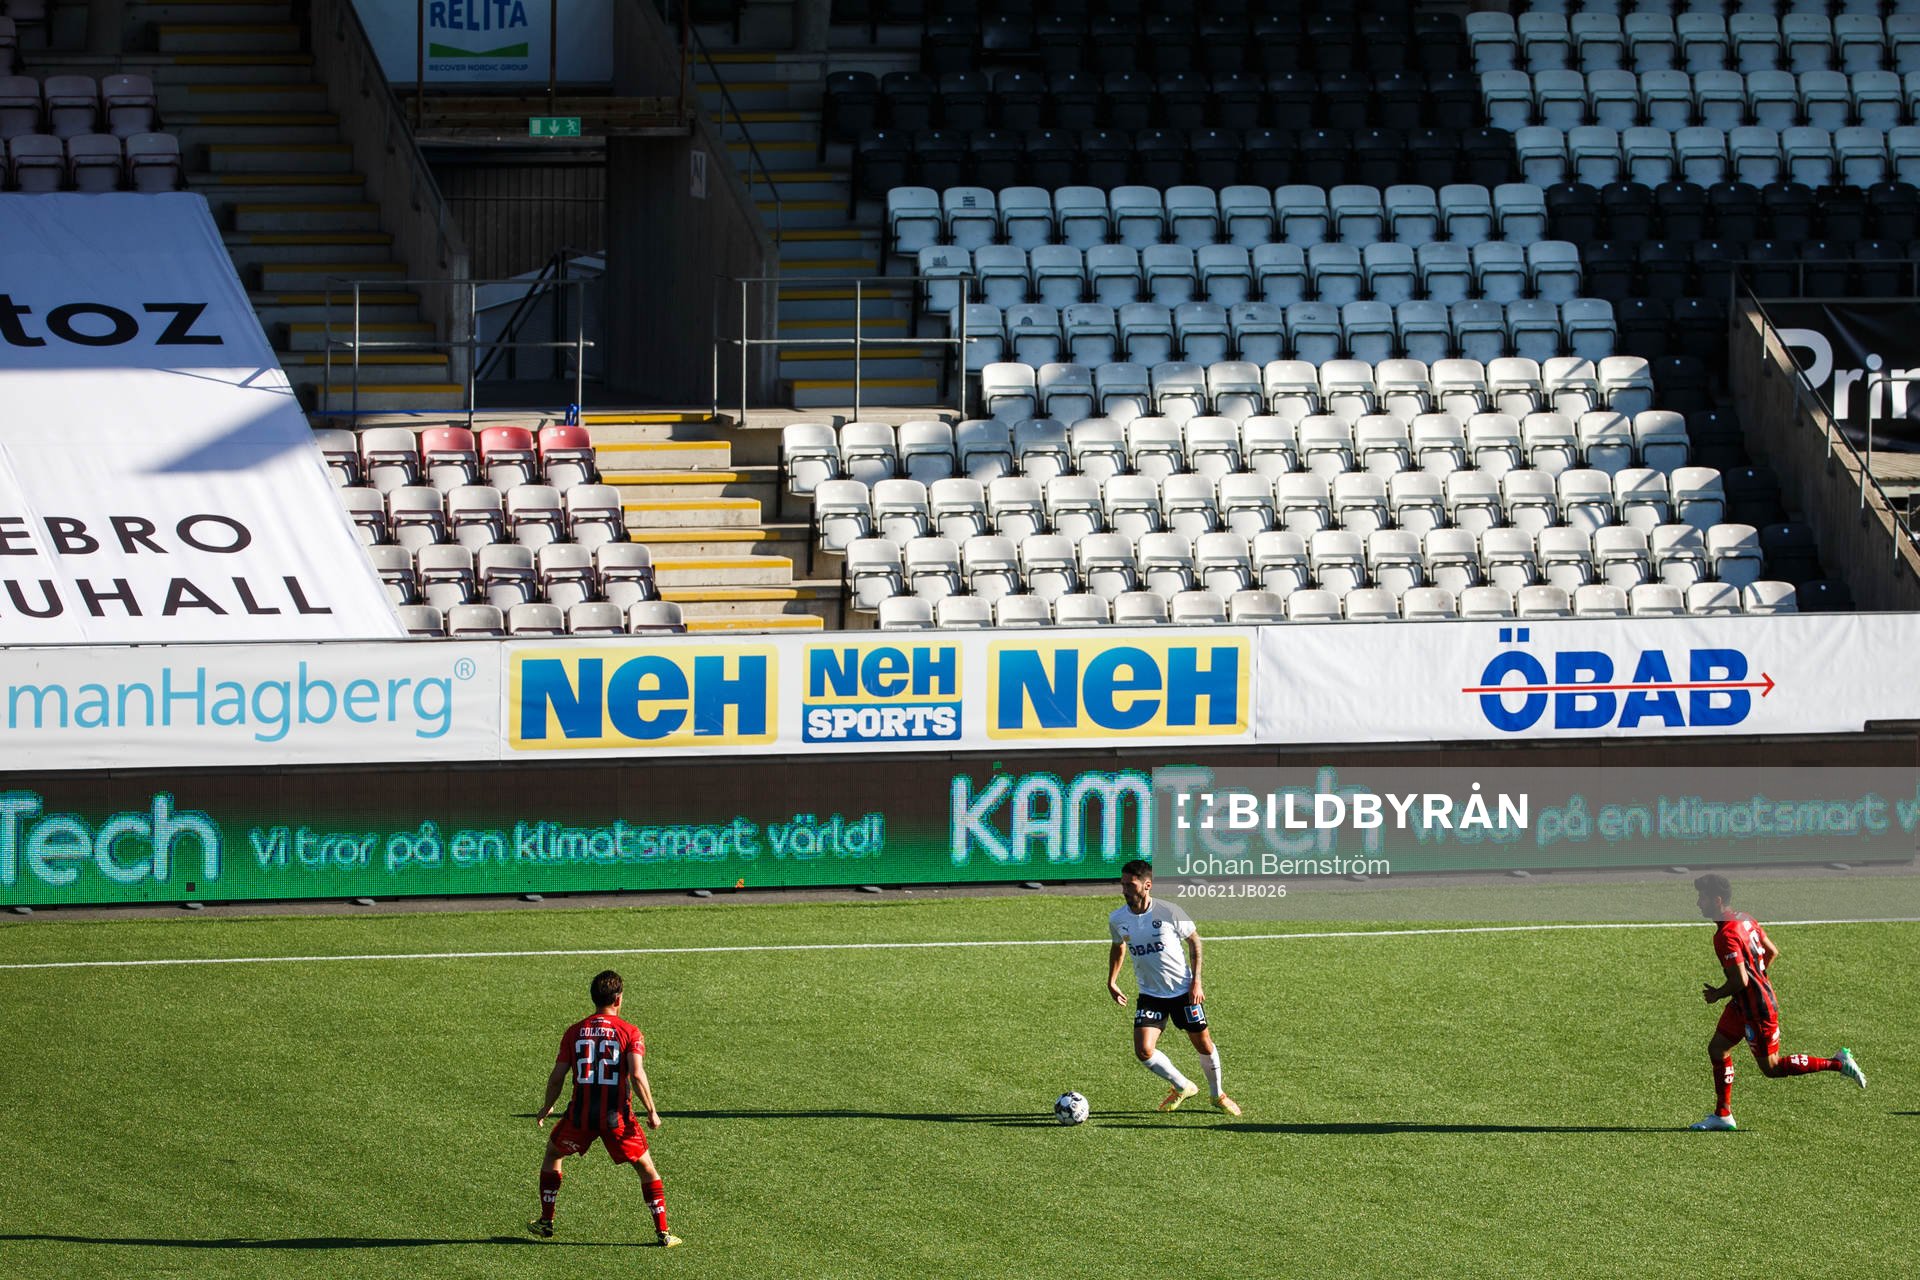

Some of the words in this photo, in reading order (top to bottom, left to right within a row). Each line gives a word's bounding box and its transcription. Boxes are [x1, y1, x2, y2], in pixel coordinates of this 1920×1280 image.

[430, 0, 528, 31] RELITA
[428, 64, 466, 72] RECOVER
[467, 64, 499, 72] NORDIC
[500, 64, 529, 72] GROUP
[0, 294, 224, 347] toz
[0, 514, 252, 554] EBRO
[0, 576, 333, 618] UHALL
[1480, 628, 1751, 731] ÖBAB
[808, 706, 957, 738] SPORTS
[1537, 793, 1592, 849] på
[1598, 803, 1654, 841] en
[1657, 793, 1889, 839] klimatsmart
[297, 826, 379, 867] tror
[386, 820, 444, 873] på
[451, 829, 508, 866] en
[513, 816, 760, 864] klimatsmart
[575, 1039, 620, 1085] 22
